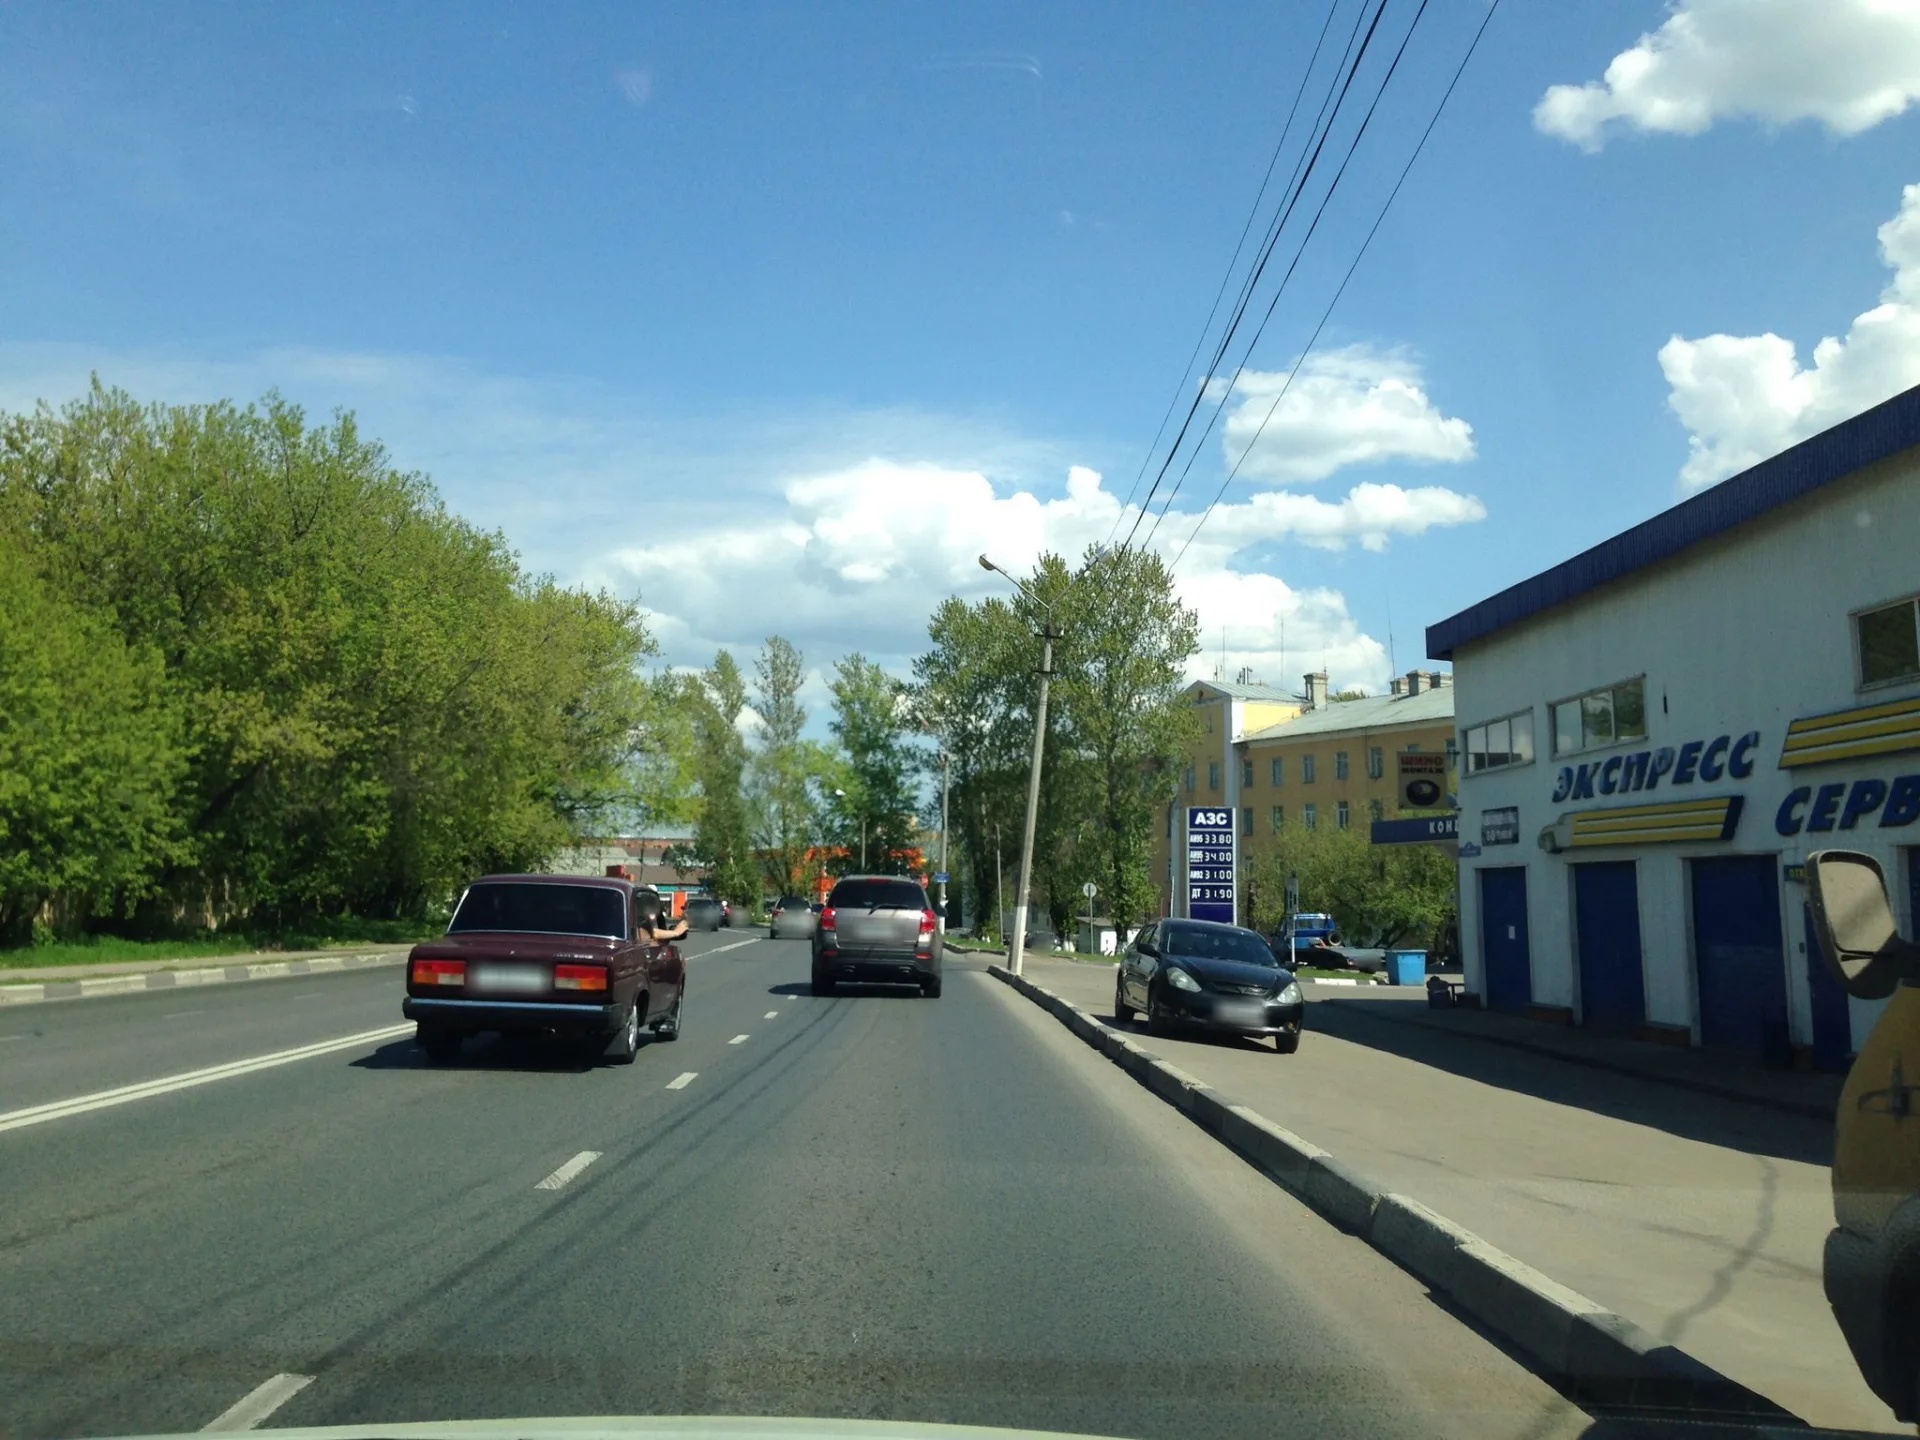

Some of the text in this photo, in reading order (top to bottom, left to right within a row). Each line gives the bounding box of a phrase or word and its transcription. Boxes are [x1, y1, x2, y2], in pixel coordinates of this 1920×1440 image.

[1552, 731, 1760, 803] ЭКСПРЕСС
[1194, 812, 1227, 825] АЗС
[1191, 888, 1201, 899] ДТ
